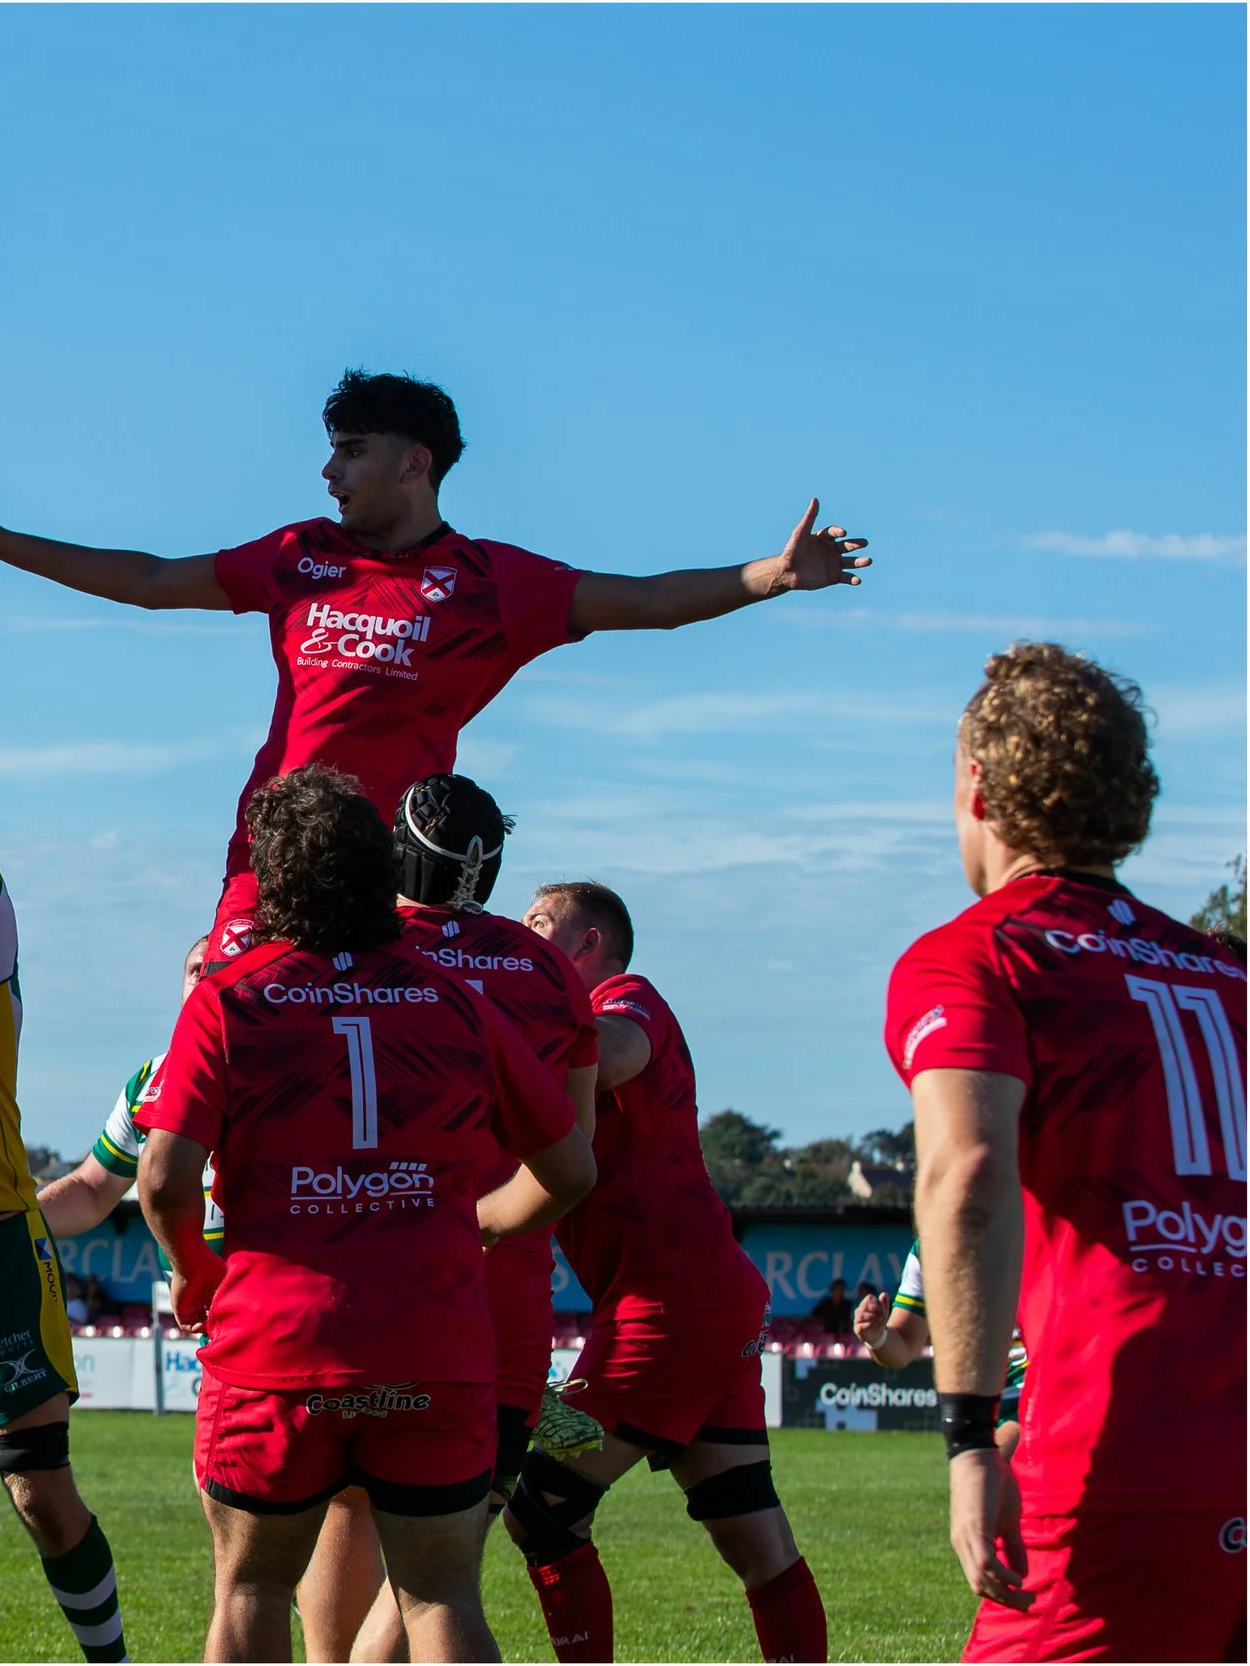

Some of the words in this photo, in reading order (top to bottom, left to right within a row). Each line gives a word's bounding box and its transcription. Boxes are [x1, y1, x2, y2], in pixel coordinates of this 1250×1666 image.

[297, 557, 346, 579] Ogier
[306, 602, 431, 642] Hacquoil
[337, 633, 415, 667] Cook
[297, 656, 329, 669] Building
[331, 658, 382, 674] Contractors
[385, 667, 419, 681] Limited
[422, 948, 534, 972] nShares
[262, 983, 439, 1004] CoinShares
[332, 1016, 378, 1150] 1
[1124, 973, 1247, 1181] 11
[291, 1162, 434, 1199] Polygon
[290, 1198, 435, 1215] COLLECTIVE
[1122, 1200, 1247, 1258] Polyg
[1131, 1256, 1246, 1278] COLLEC
[306, 1389, 431, 1415] Coastline
[820, 1382, 937, 1408] CoinShares
